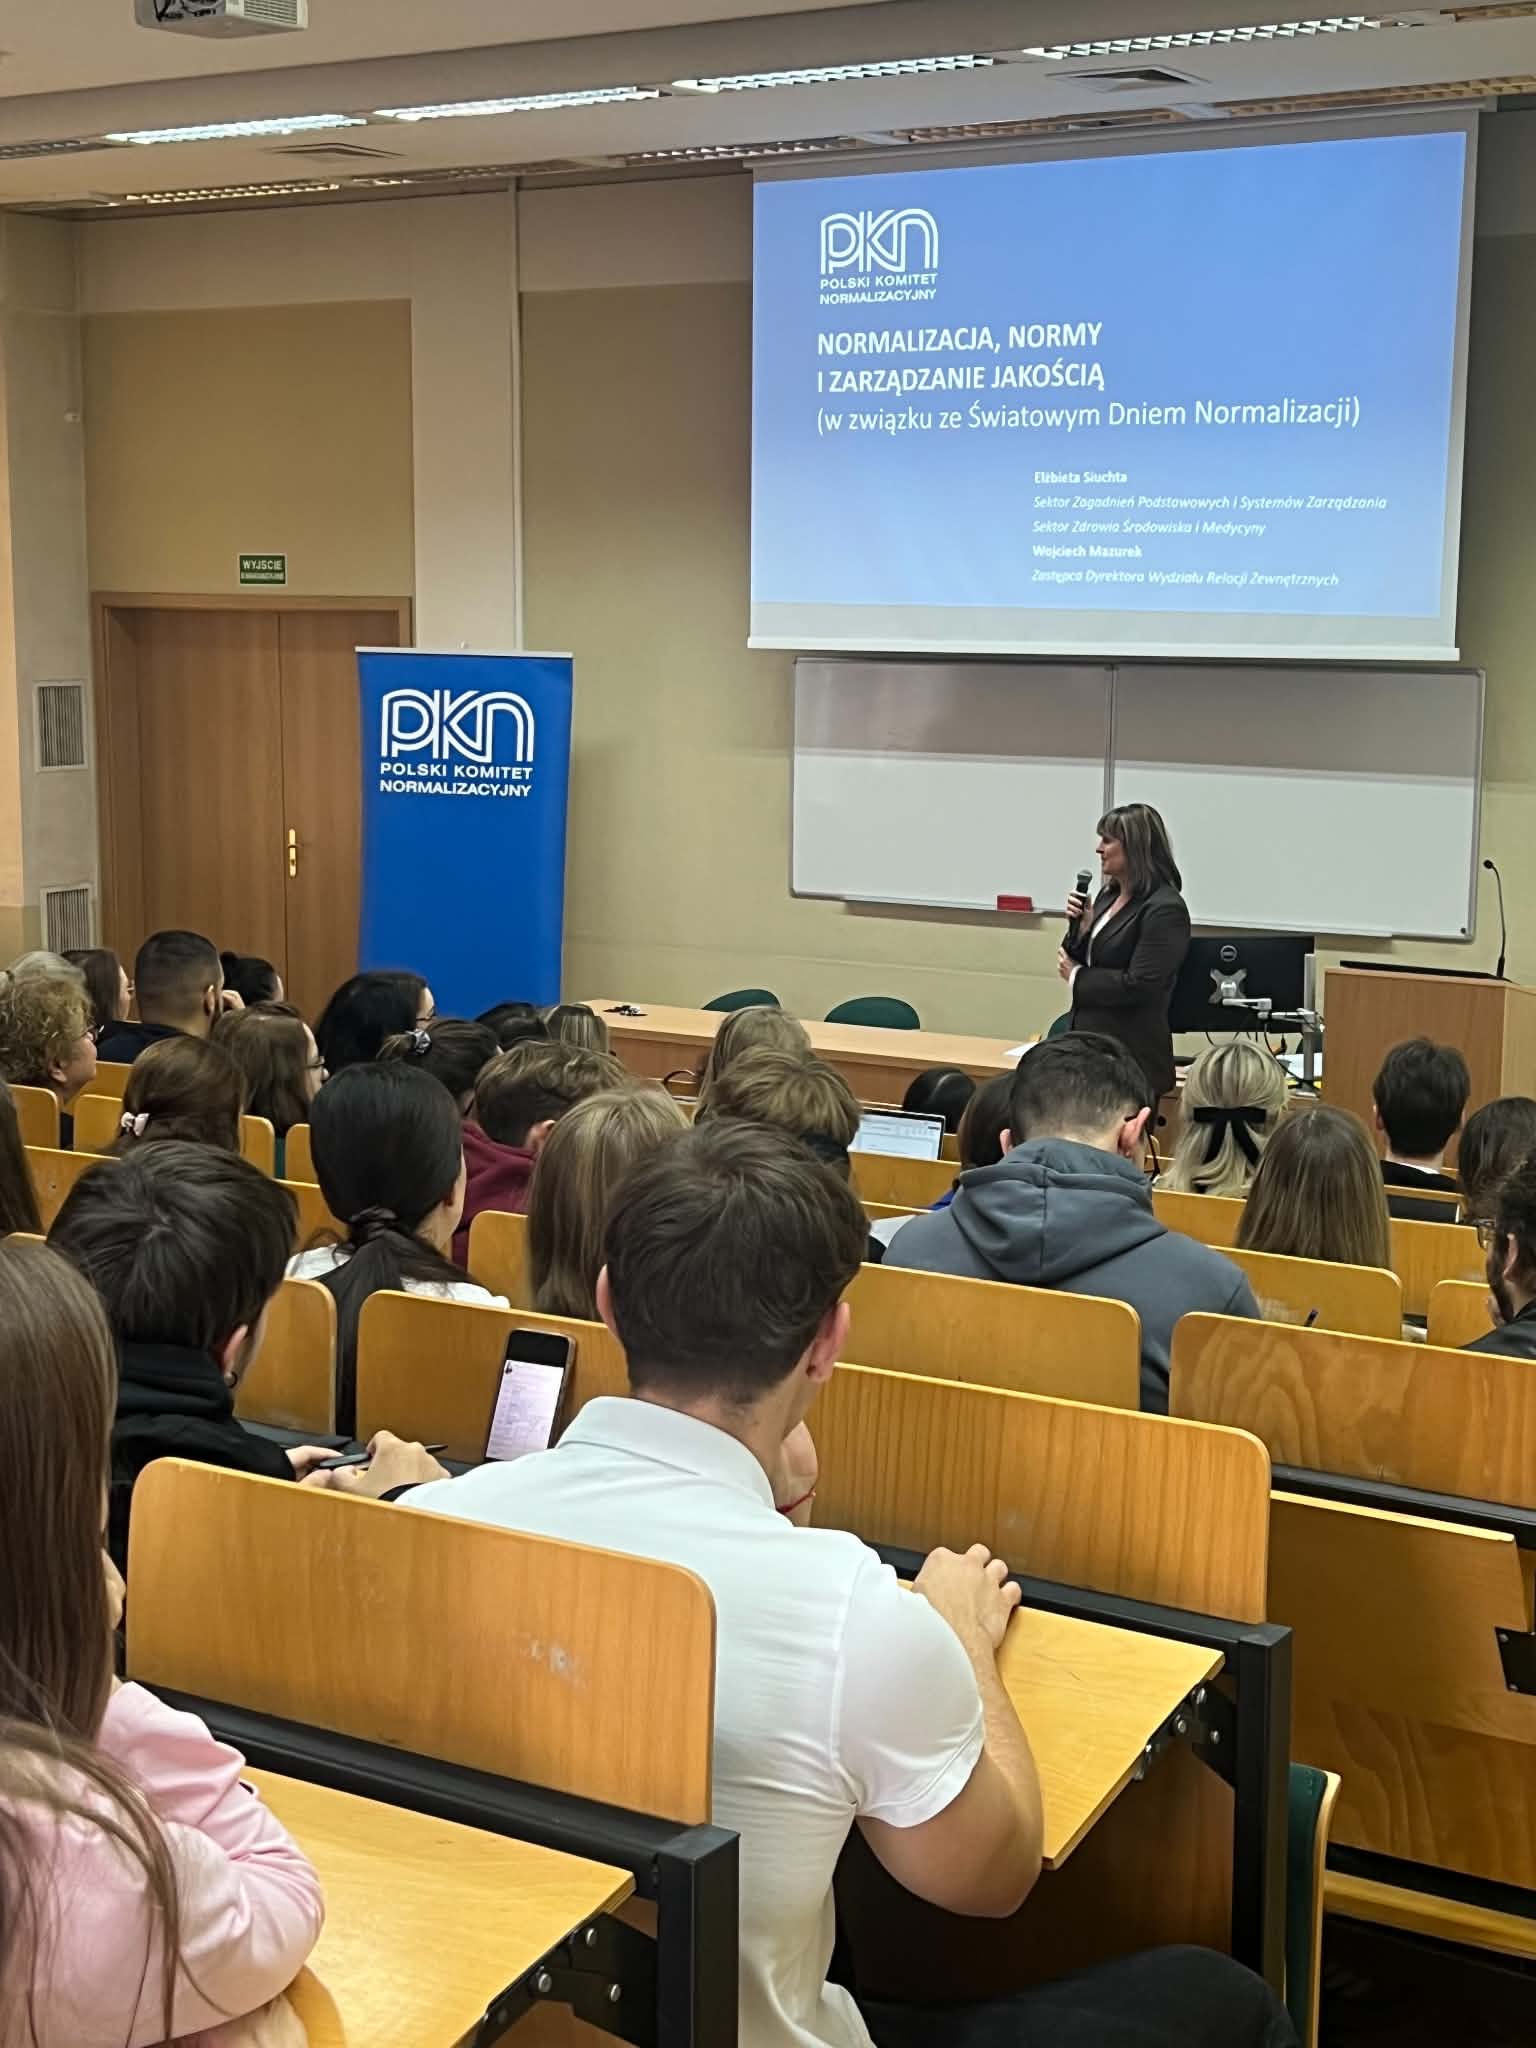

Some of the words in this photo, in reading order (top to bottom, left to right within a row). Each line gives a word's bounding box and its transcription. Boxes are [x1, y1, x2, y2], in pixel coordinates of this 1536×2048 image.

[820, 277, 870, 290] POLSKI
[875, 273, 937, 287] KOMITET
[820, 288, 937, 305] NORMALIZACYJNY
[818, 326, 1000, 355] NORMALIZACJA,
[1008, 322, 1102, 348] NORMY
[817, 371, 823, 392] I
[829, 366, 985, 397] ZARZĄDZANIE
[991, 357, 1105, 391] JAKOŚCIĄ
[817, 407, 842, 436] (w
[848, 406, 932, 436] związku
[939, 410, 962, 429] ze
[968, 400, 1100, 432] Światowym
[1109, 401, 1186, 426] Dniem
[1195, 396, 1360, 428] Normalizacji)
[1033, 496, 1072, 509] Sektor
[1072, 496, 1134, 511] Zagadnień
[1137, 496, 1230, 511] Podstawowych
[1240, 496, 1304, 511] Systemów
[1306, 496, 1388, 511] Zarządzania
[1032, 520, 1068, 533] Sektor
[1072, 520, 1120, 533] Zdrowia
[1202, 521, 1266, 536] Medycyny
[1032, 545, 1086, 559] Wojciech
[1089, 545, 1142, 557] Mazurek
[1085, 570, 1145, 584] Dyrektora
[380, 762, 447, 777] POLSKI
[454, 765, 533, 780] KOMITET
[380, 779, 532, 797] NORMALIZACYJNY
